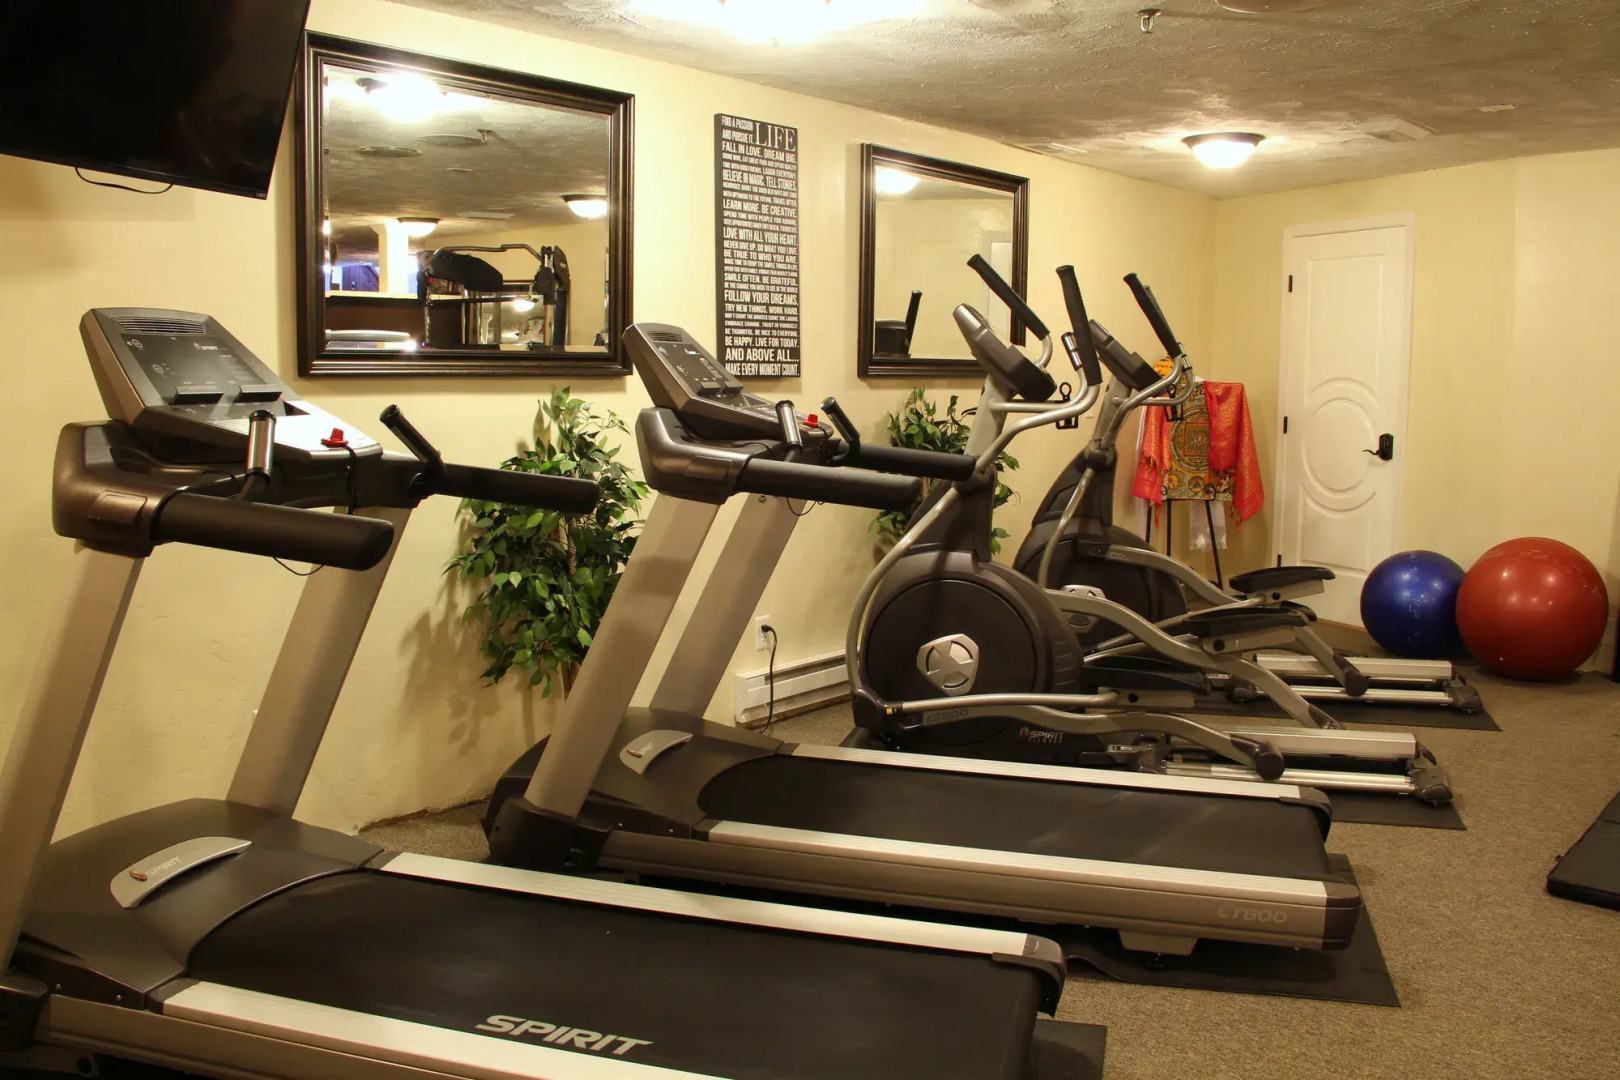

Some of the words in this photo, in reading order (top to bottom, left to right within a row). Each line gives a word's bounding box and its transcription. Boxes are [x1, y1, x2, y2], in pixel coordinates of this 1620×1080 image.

[755, 122, 795, 151] LIFE
[722, 141, 737, 153] FALL
[738, 143, 744, 154] IN
[764, 148, 784, 161] DREAM
[723, 169, 742, 183] BELIEVE
[766, 176, 776, 188] TELL
[723, 198, 742, 211] LEARN
[762, 203, 769, 214] BE
[724, 227, 738, 239] LOVE
[739, 228, 752, 241] WITH
[753, 230, 763, 242] ALL
[764, 231, 779, 243] YOUR
[724, 249, 732, 258] BE
[733, 250, 748, 259] TRUE
[750, 251, 757, 260] TO
[758, 252, 771, 261] WHO
[772, 253, 784, 262] YOU
[724, 272, 741, 282] SMILE
[763, 275, 769, 284] BE
[725, 289, 751, 303] FOLLOW
[752, 291, 769, 304] YOUR
[770, 292, 798, 305] DREAMS.
[725, 303, 734, 312] TRY
[735, 304, 747, 313] NEW
[769, 305, 783, 314] WORK
[725, 337, 733, 347] BE
[734, 337, 754, 347] HAPPY.
[755, 337, 768, 347] LIVE
[769, 337, 779, 347] FOR
[780, 338, 799, 347] TODAY.
[726, 348, 744, 361] AND
[746, 348, 775, 361] ABOVE
[776, 348, 799, 361] ALL...
[725, 363, 741, 376] MAKE
[741, 363, 759, 375] EVERY
[759, 363, 781, 375] MOMENT
[1030, 730, 1064, 739] SPIRIT
[145, 856, 182, 876] SPIRIT
[474, 1014, 653, 1056] SPIRIT
